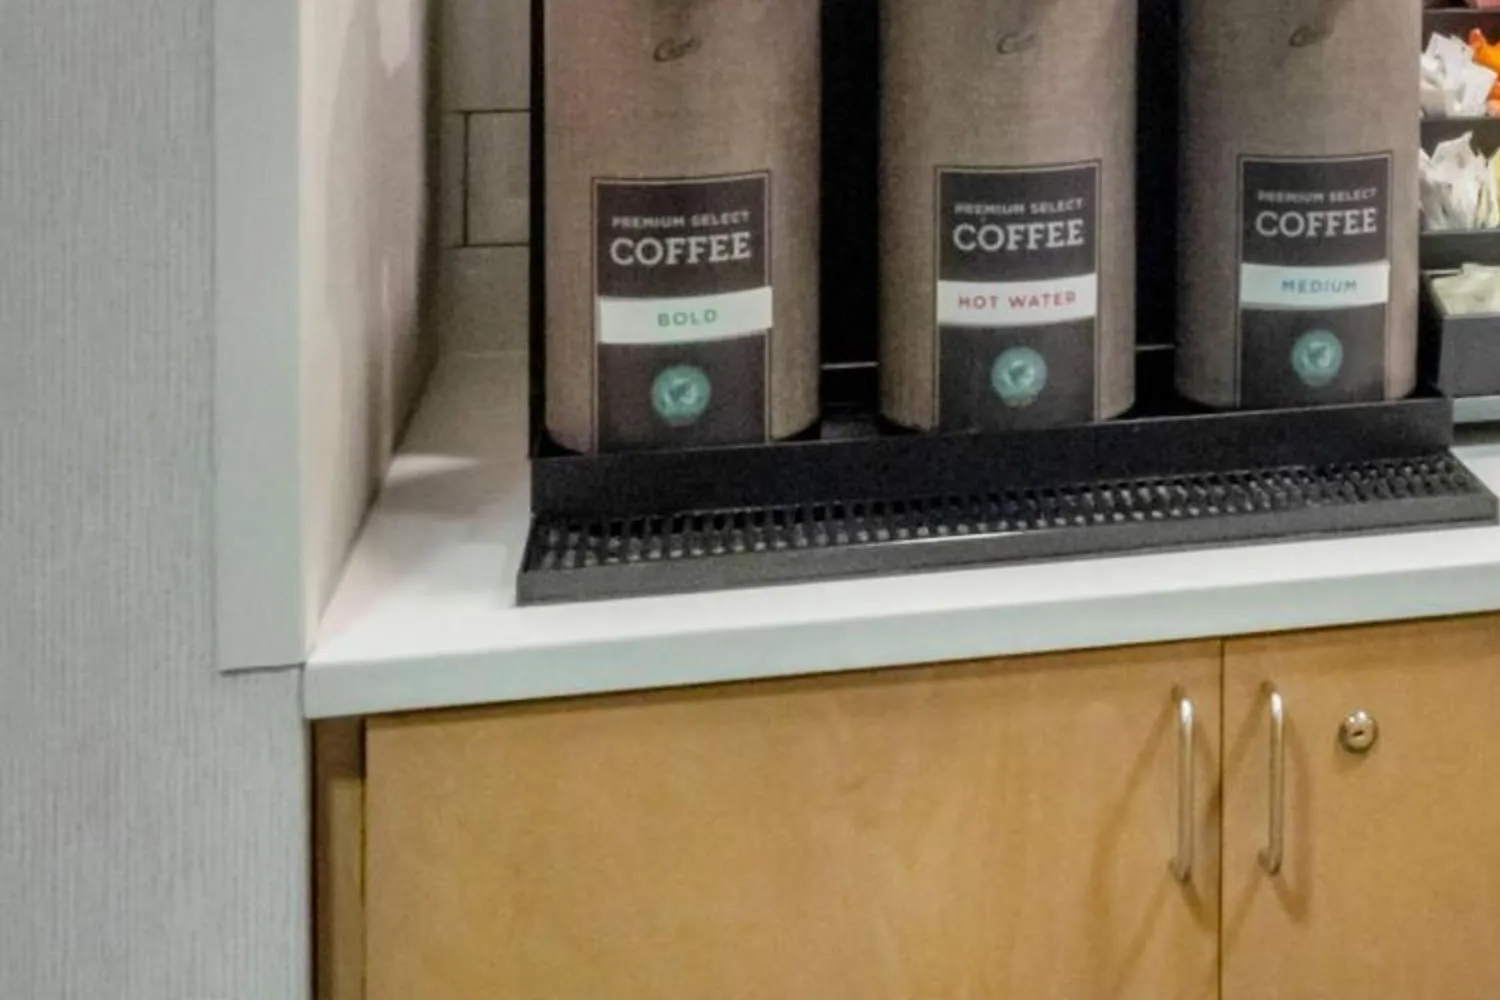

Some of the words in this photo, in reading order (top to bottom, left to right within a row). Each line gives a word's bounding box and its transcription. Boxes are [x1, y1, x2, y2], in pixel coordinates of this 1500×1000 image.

[1257, 188, 1324, 203] PREMIUM
[1328, 187, 1377, 201] SELECT
[954, 202, 1026, 215] PREMIUM
[1029, 198, 1083, 214] SELECT
[611, 215, 686, 228] PREMIUM
[690, 210, 750, 227] SELECT
[1256, 207, 1378, 238] COFFEE
[953, 219, 1084, 252] COFFEE
[609, 231, 751, 266] COFFEE
[1281, 279, 1358, 294] MEDIUM
[958, 295, 999, 309] HOT
[1007, 291, 1077, 309] WATER
[657, 308, 718, 328] BOLD
